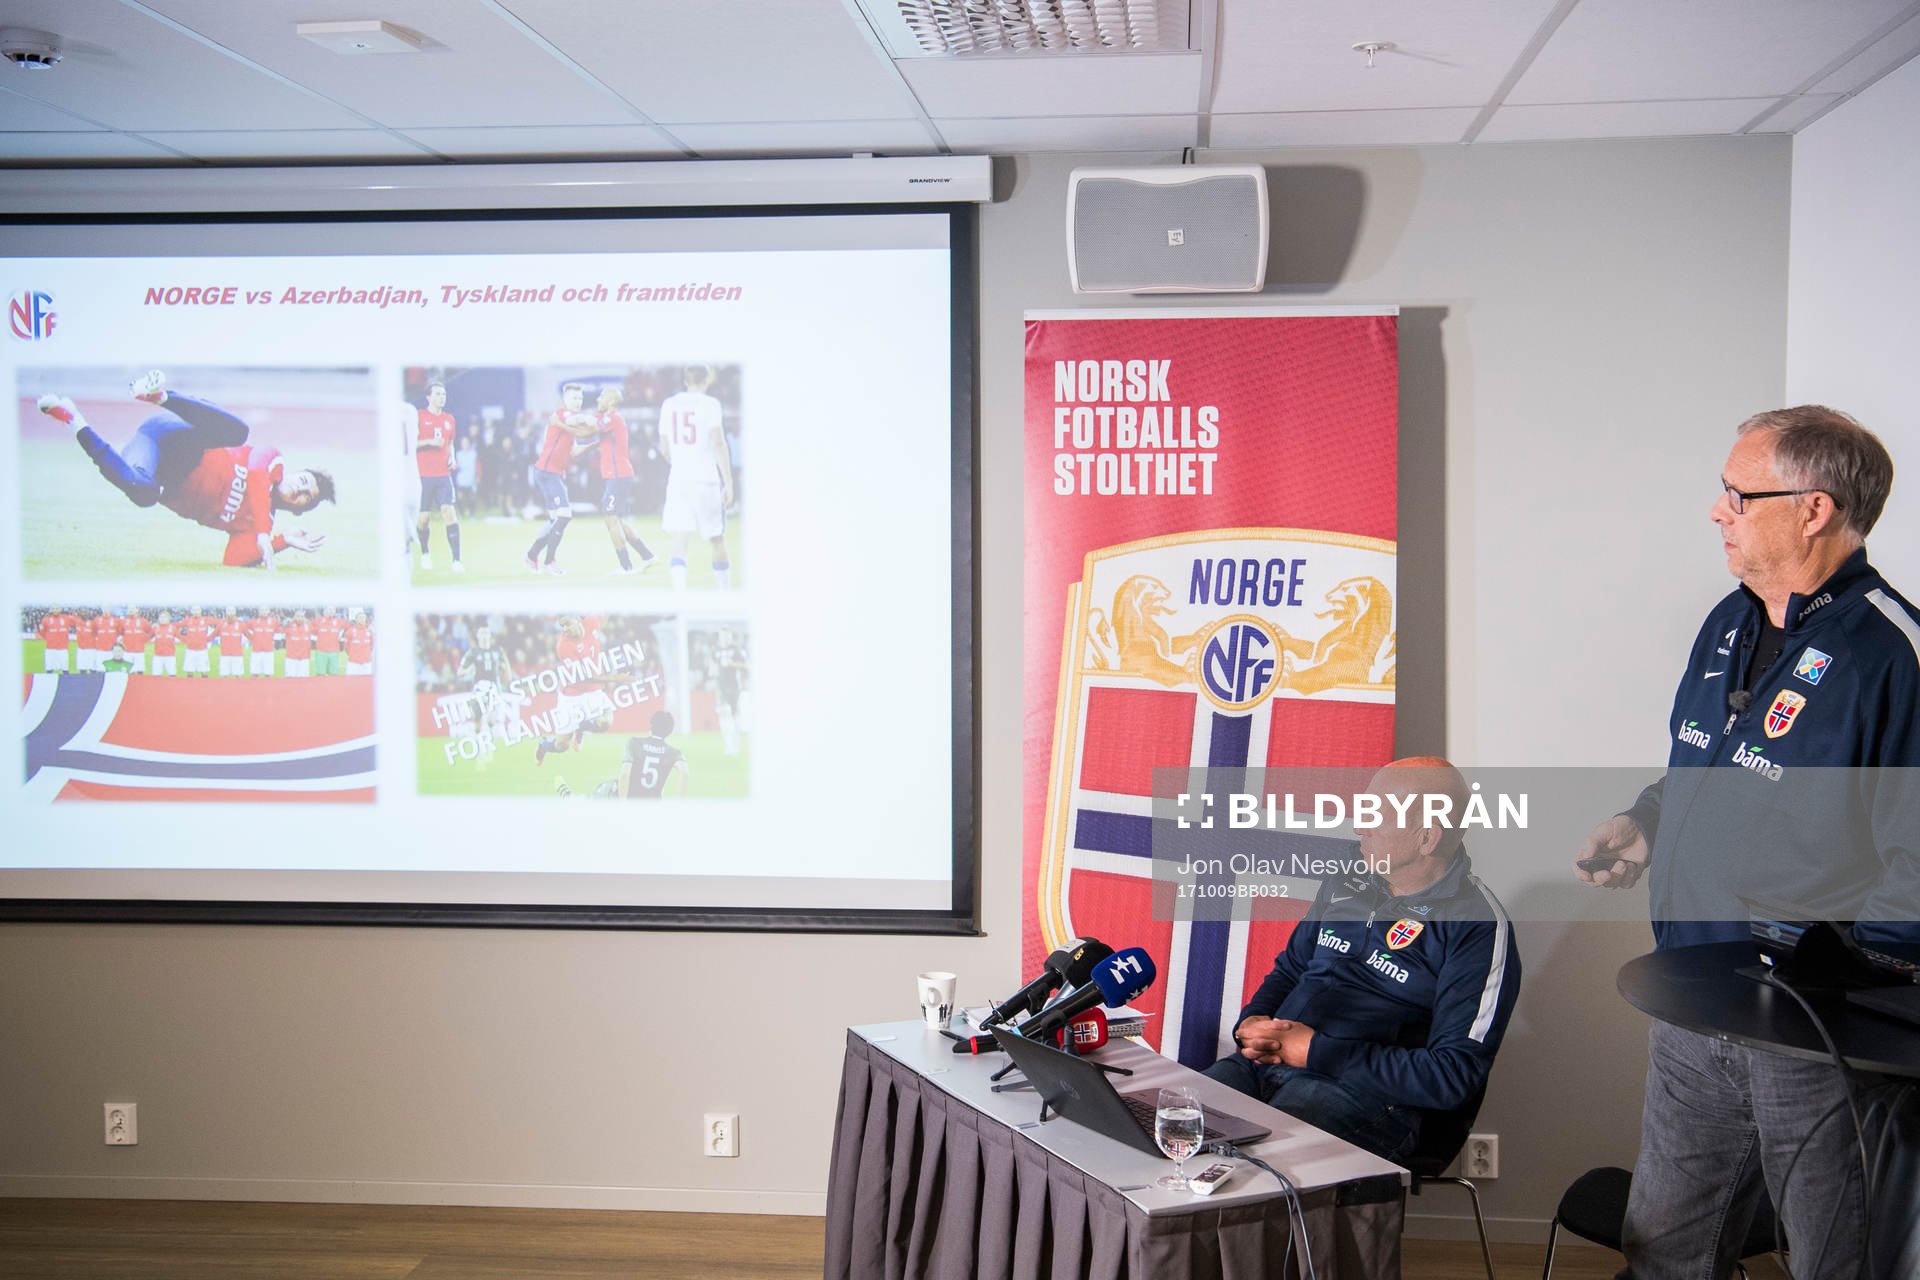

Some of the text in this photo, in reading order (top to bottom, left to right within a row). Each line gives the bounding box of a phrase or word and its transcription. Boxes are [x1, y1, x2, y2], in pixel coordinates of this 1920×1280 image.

[144, 282, 743, 309] NORGE vs Azerbadjan, Tyskland och framtiden
[1054, 359, 1172, 402] NORSK
[672, 411, 697, 446] 15
[1054, 406, 1219, 449] FOTBALLS
[1054, 453, 1218, 495] STOLTHET
[1189, 558, 1307, 607] NORGE
[509, 640, 646, 699] STOMMEN
[444, 731, 497, 766] FOR
[1731, 742, 1784, 782] bama
[640, 756, 660, 788] 5
[1366, 949, 1409, 983] bama
